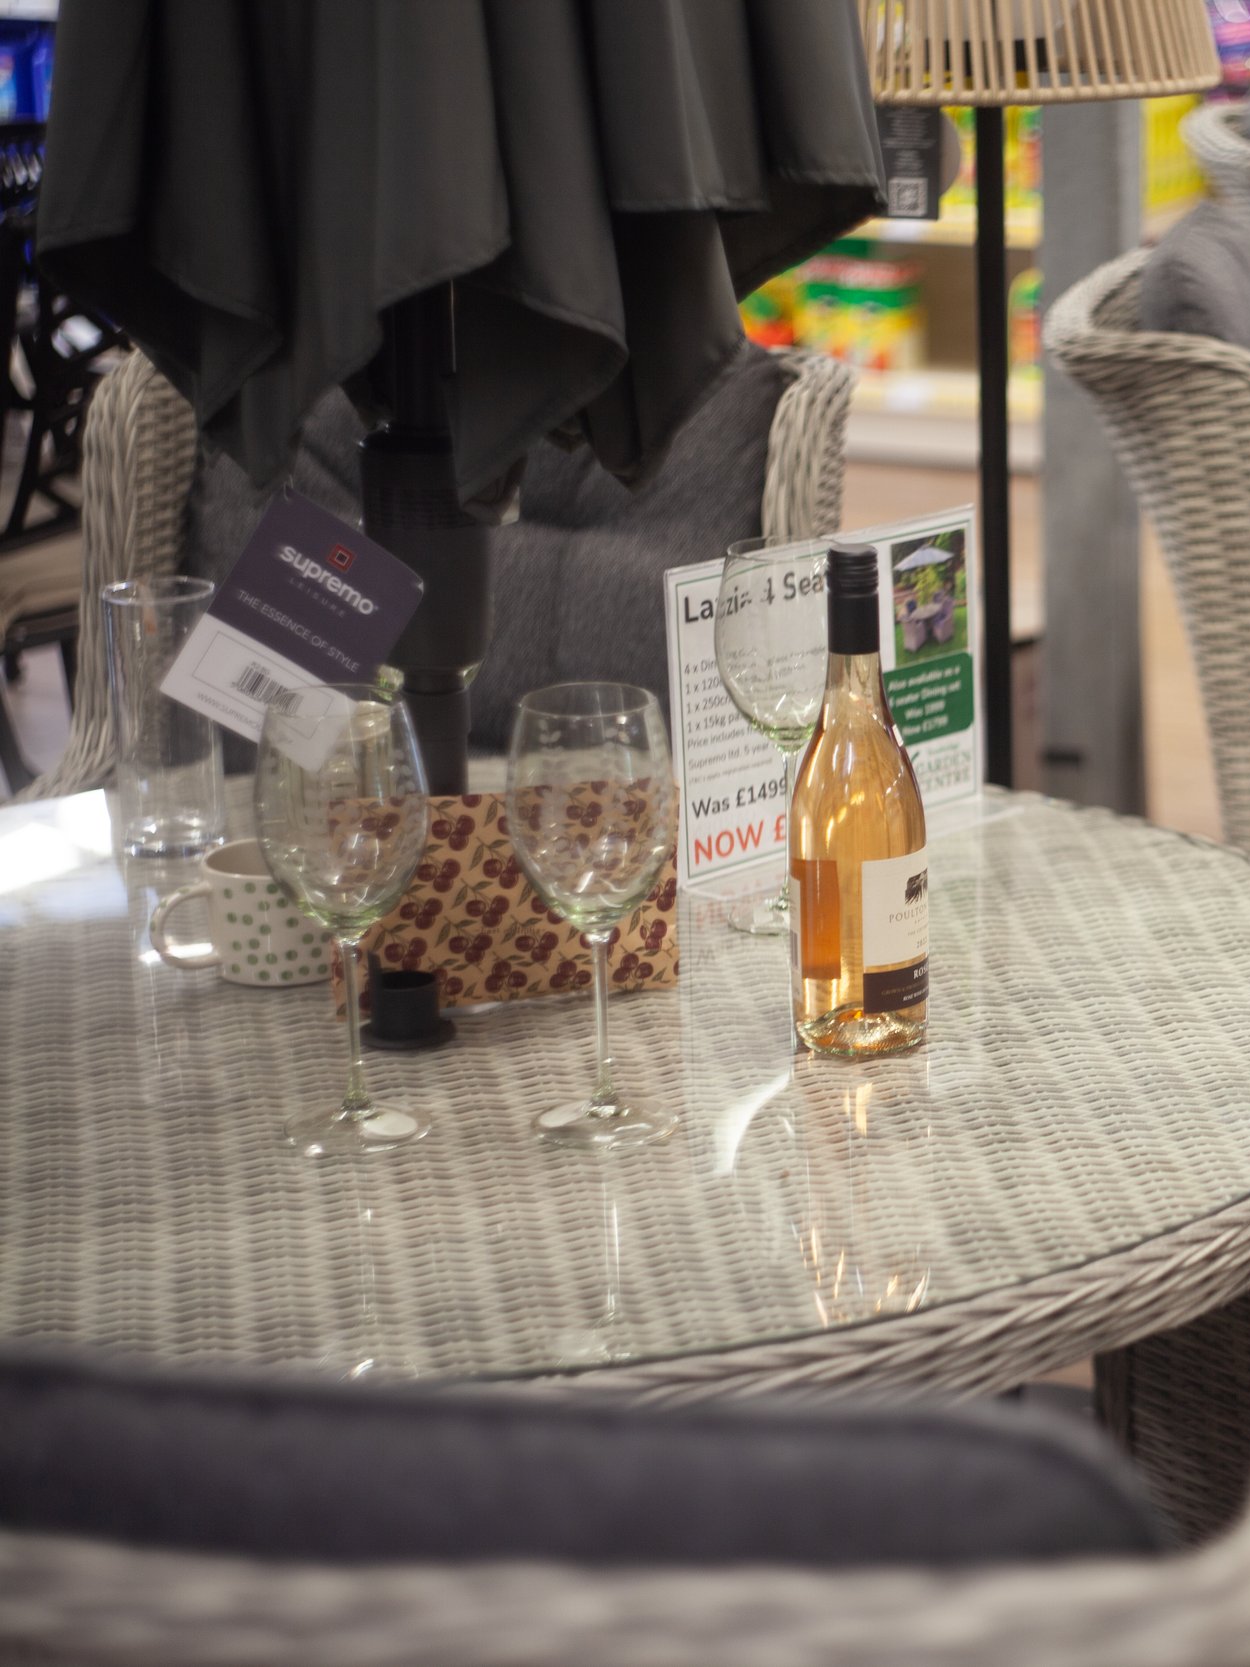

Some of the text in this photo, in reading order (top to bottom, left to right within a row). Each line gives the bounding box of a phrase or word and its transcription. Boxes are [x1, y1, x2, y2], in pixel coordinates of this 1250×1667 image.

[280, 546, 374, 615] supremo
[238, 589, 360, 673] THE ESSENCE OF STYLE
[684, 663, 691, 674] 4
[908, 669, 943, 688] available
[685, 684, 690, 695] 1
[895, 692, 920, 707] seater
[920, 685, 947, 700] Dining
[686, 702, 691, 714] 1
[695, 703, 700, 711] x
[687, 722, 692, 733] 1
[695, 722, 701, 731] x
[704, 714, 726, 730] 15kg
[687, 736, 708, 750] Price
[710, 727, 745, 744] includes
[689, 755, 727, 770] Supremo
[744, 744, 750, 755] 5
[752, 742, 769, 756] year
[916, 752, 971, 775] GARDEN
[919, 767, 970, 793] CENTRE
[692, 777, 787, 818] Was £1499
[694, 820, 764, 865] NOW
